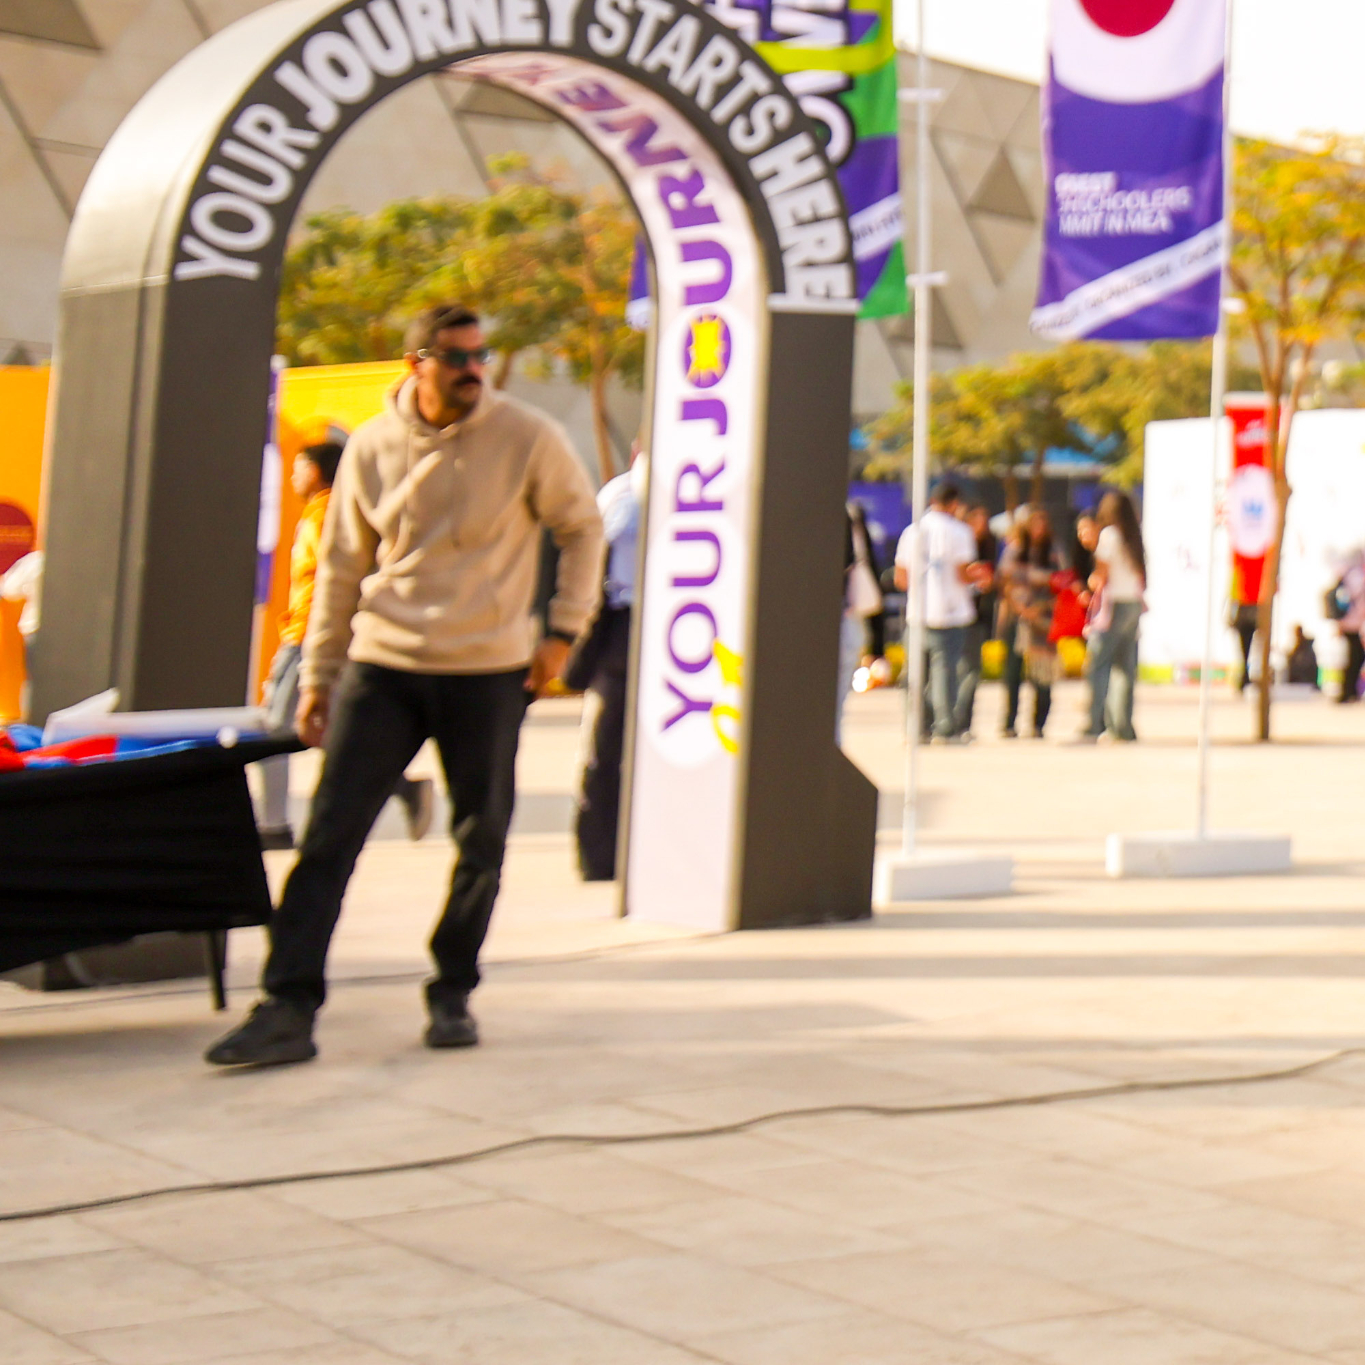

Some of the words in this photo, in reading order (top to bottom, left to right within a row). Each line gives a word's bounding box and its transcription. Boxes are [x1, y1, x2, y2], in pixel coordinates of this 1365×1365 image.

[174, 102, 322, 282] YOUR
[747, 130, 856, 302] HERE
[661, 456, 726, 733] YOUR
